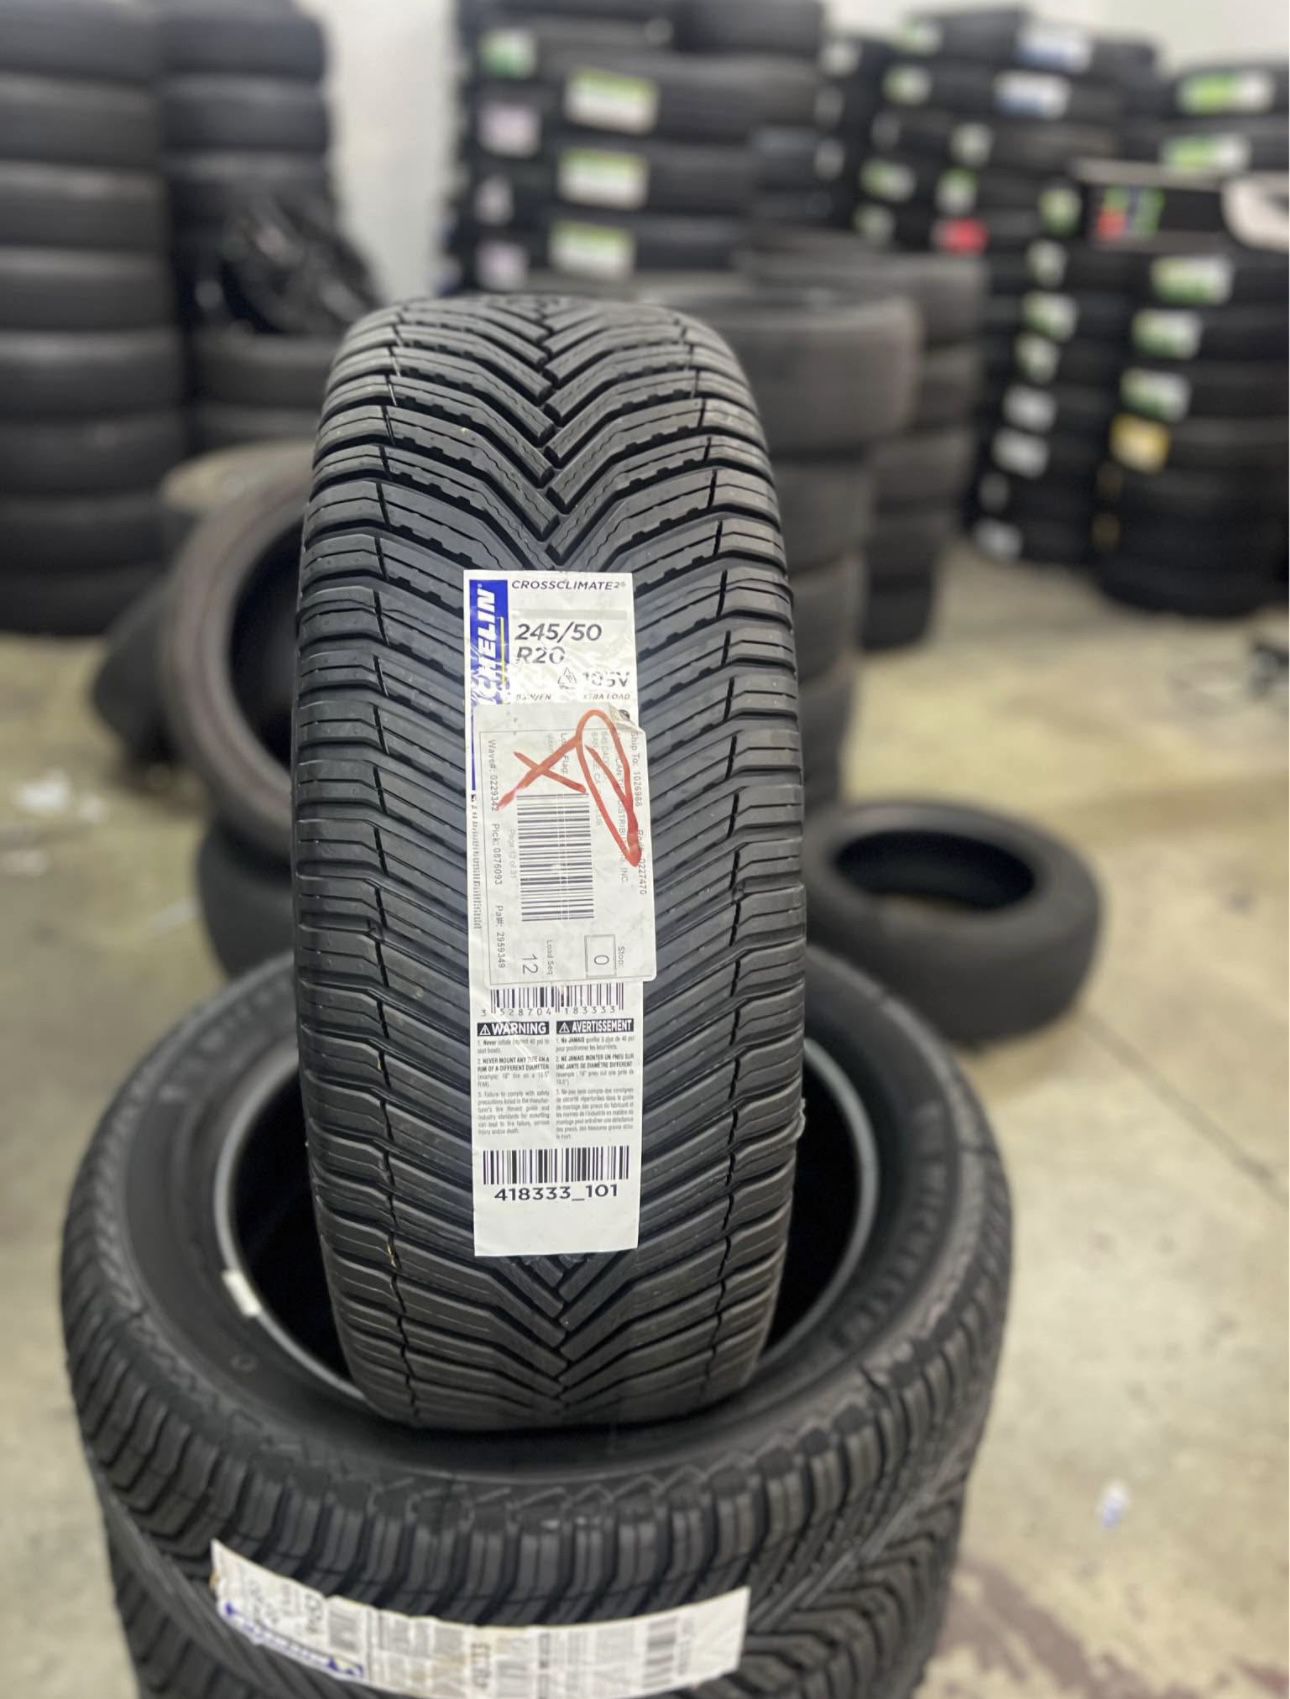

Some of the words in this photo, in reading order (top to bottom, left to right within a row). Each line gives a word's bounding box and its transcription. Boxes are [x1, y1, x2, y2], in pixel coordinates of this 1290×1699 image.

[514, 621, 602, 643] 245/50
[477, 588, 497, 704] ICHELIN
[515, 646, 566, 664] R20
[631, 732, 642, 751] Ship
[493, 848, 503, 885] 0876093
[522, 953, 539, 974] 12
[593, 954, 610, 966] 0
[480, 1009, 487, 1017] 3
[500, 1008, 551, 1017] 528704
[564, 1005, 616, 1015] 183333
[491, 1022, 547, 1035] WARNING
[571, 1019, 632, 1032] AVERTISSEMENT
[494, 1183, 618, 1202] 418333_101
